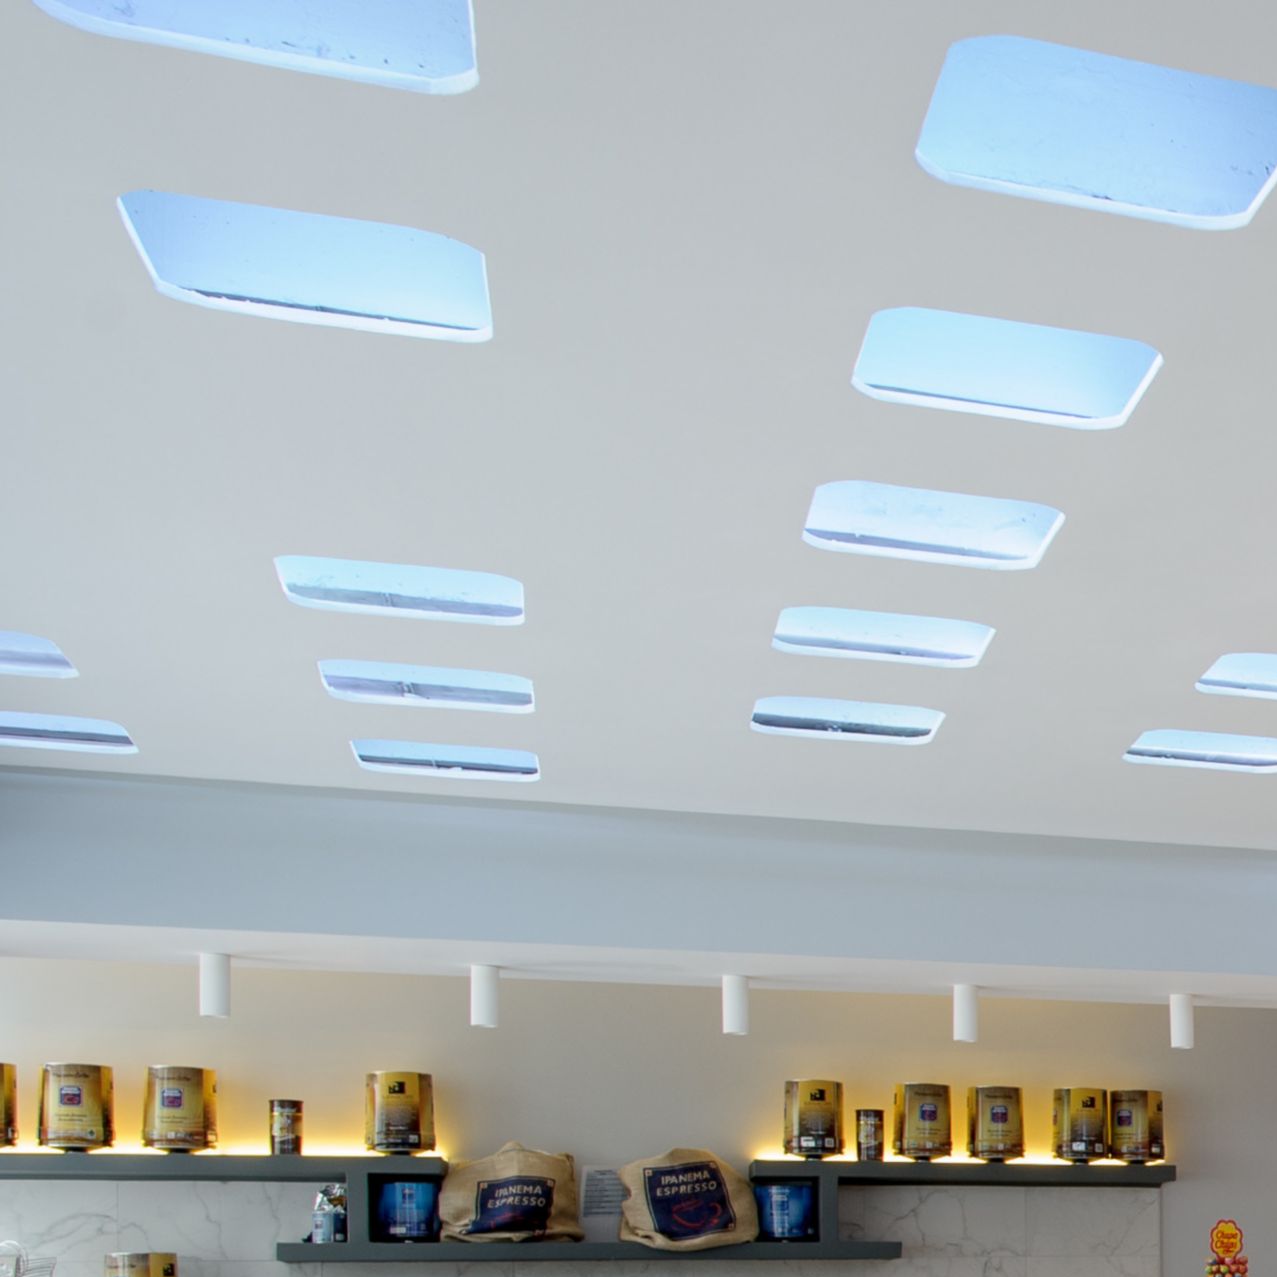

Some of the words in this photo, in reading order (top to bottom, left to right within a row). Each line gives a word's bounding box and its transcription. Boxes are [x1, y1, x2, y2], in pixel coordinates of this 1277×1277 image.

[661, 1169, 711, 1185] IPANEMA
[495, 1184, 542, 1197] IPANEMA
[656, 1181, 717, 1197] ESPRESSO
[487, 1196, 546, 1209] ESPRESSO
